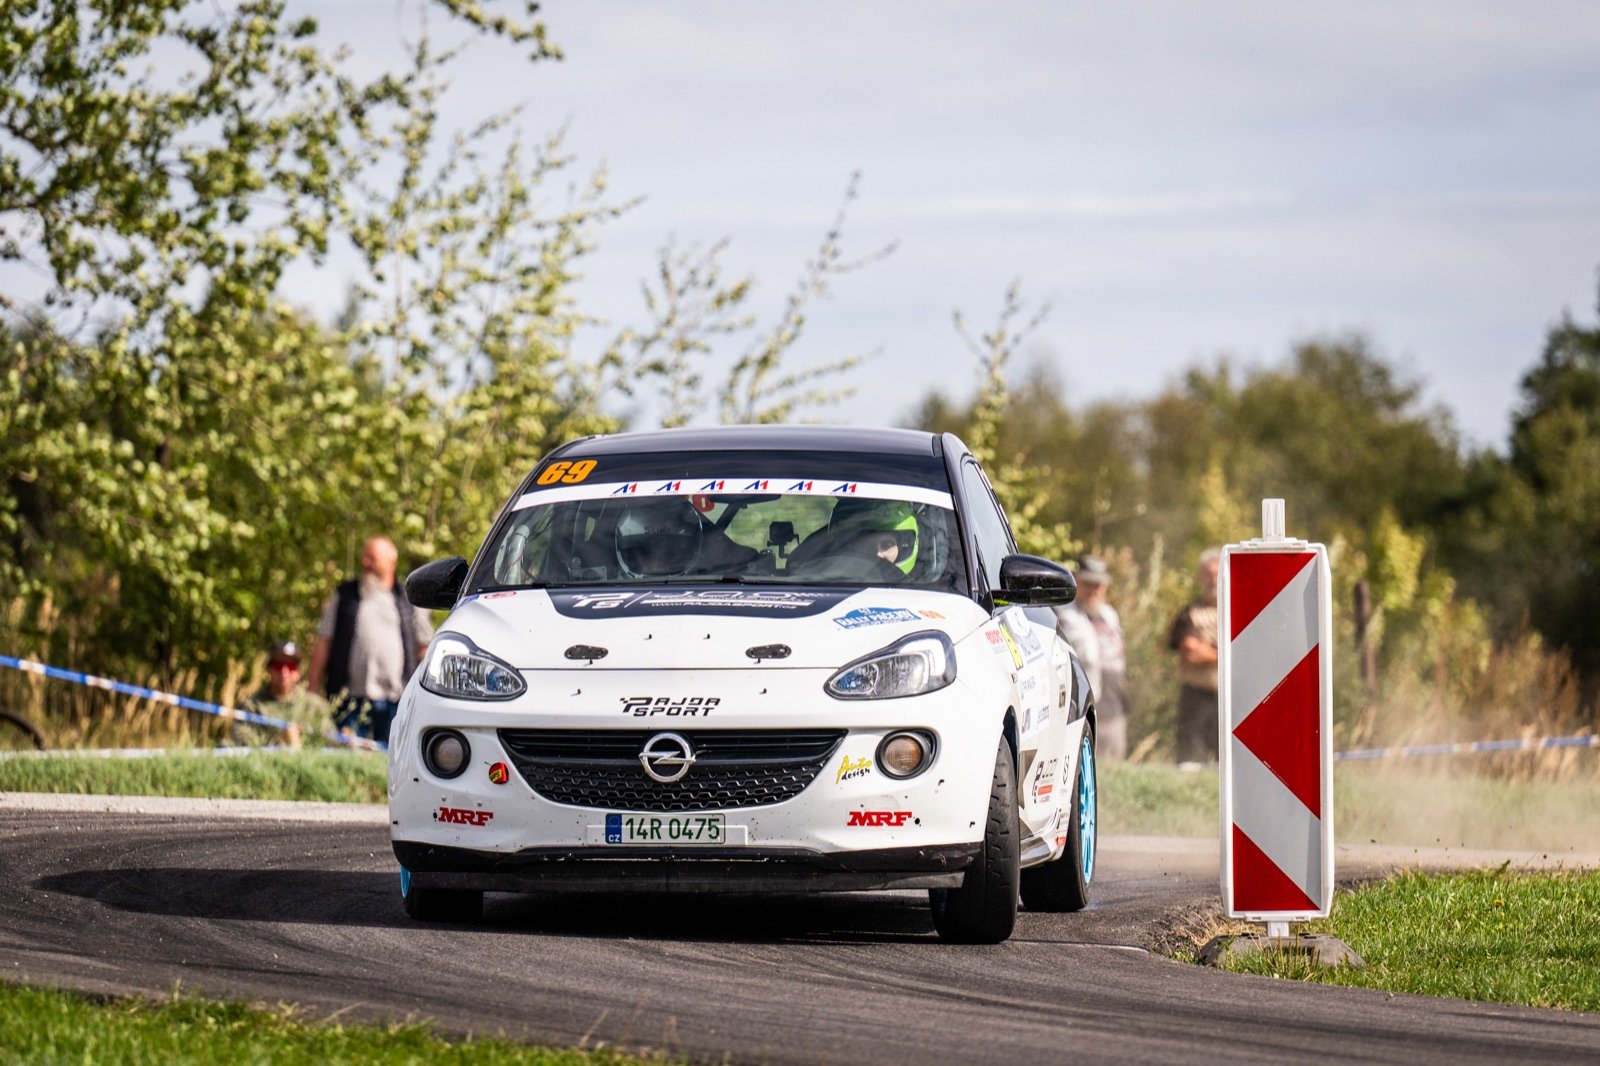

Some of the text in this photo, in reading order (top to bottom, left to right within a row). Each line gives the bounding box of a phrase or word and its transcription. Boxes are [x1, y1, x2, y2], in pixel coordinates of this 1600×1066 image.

[536, 460, 598, 485] 69
[633, 707, 714, 717] SPORT
[841, 767, 870, 781] design
[438, 807, 493, 826] MRF
[847, 811, 912, 826] MRF
[625, 818, 720, 839] 14R 0475
[608, 834, 620, 842] CZ
